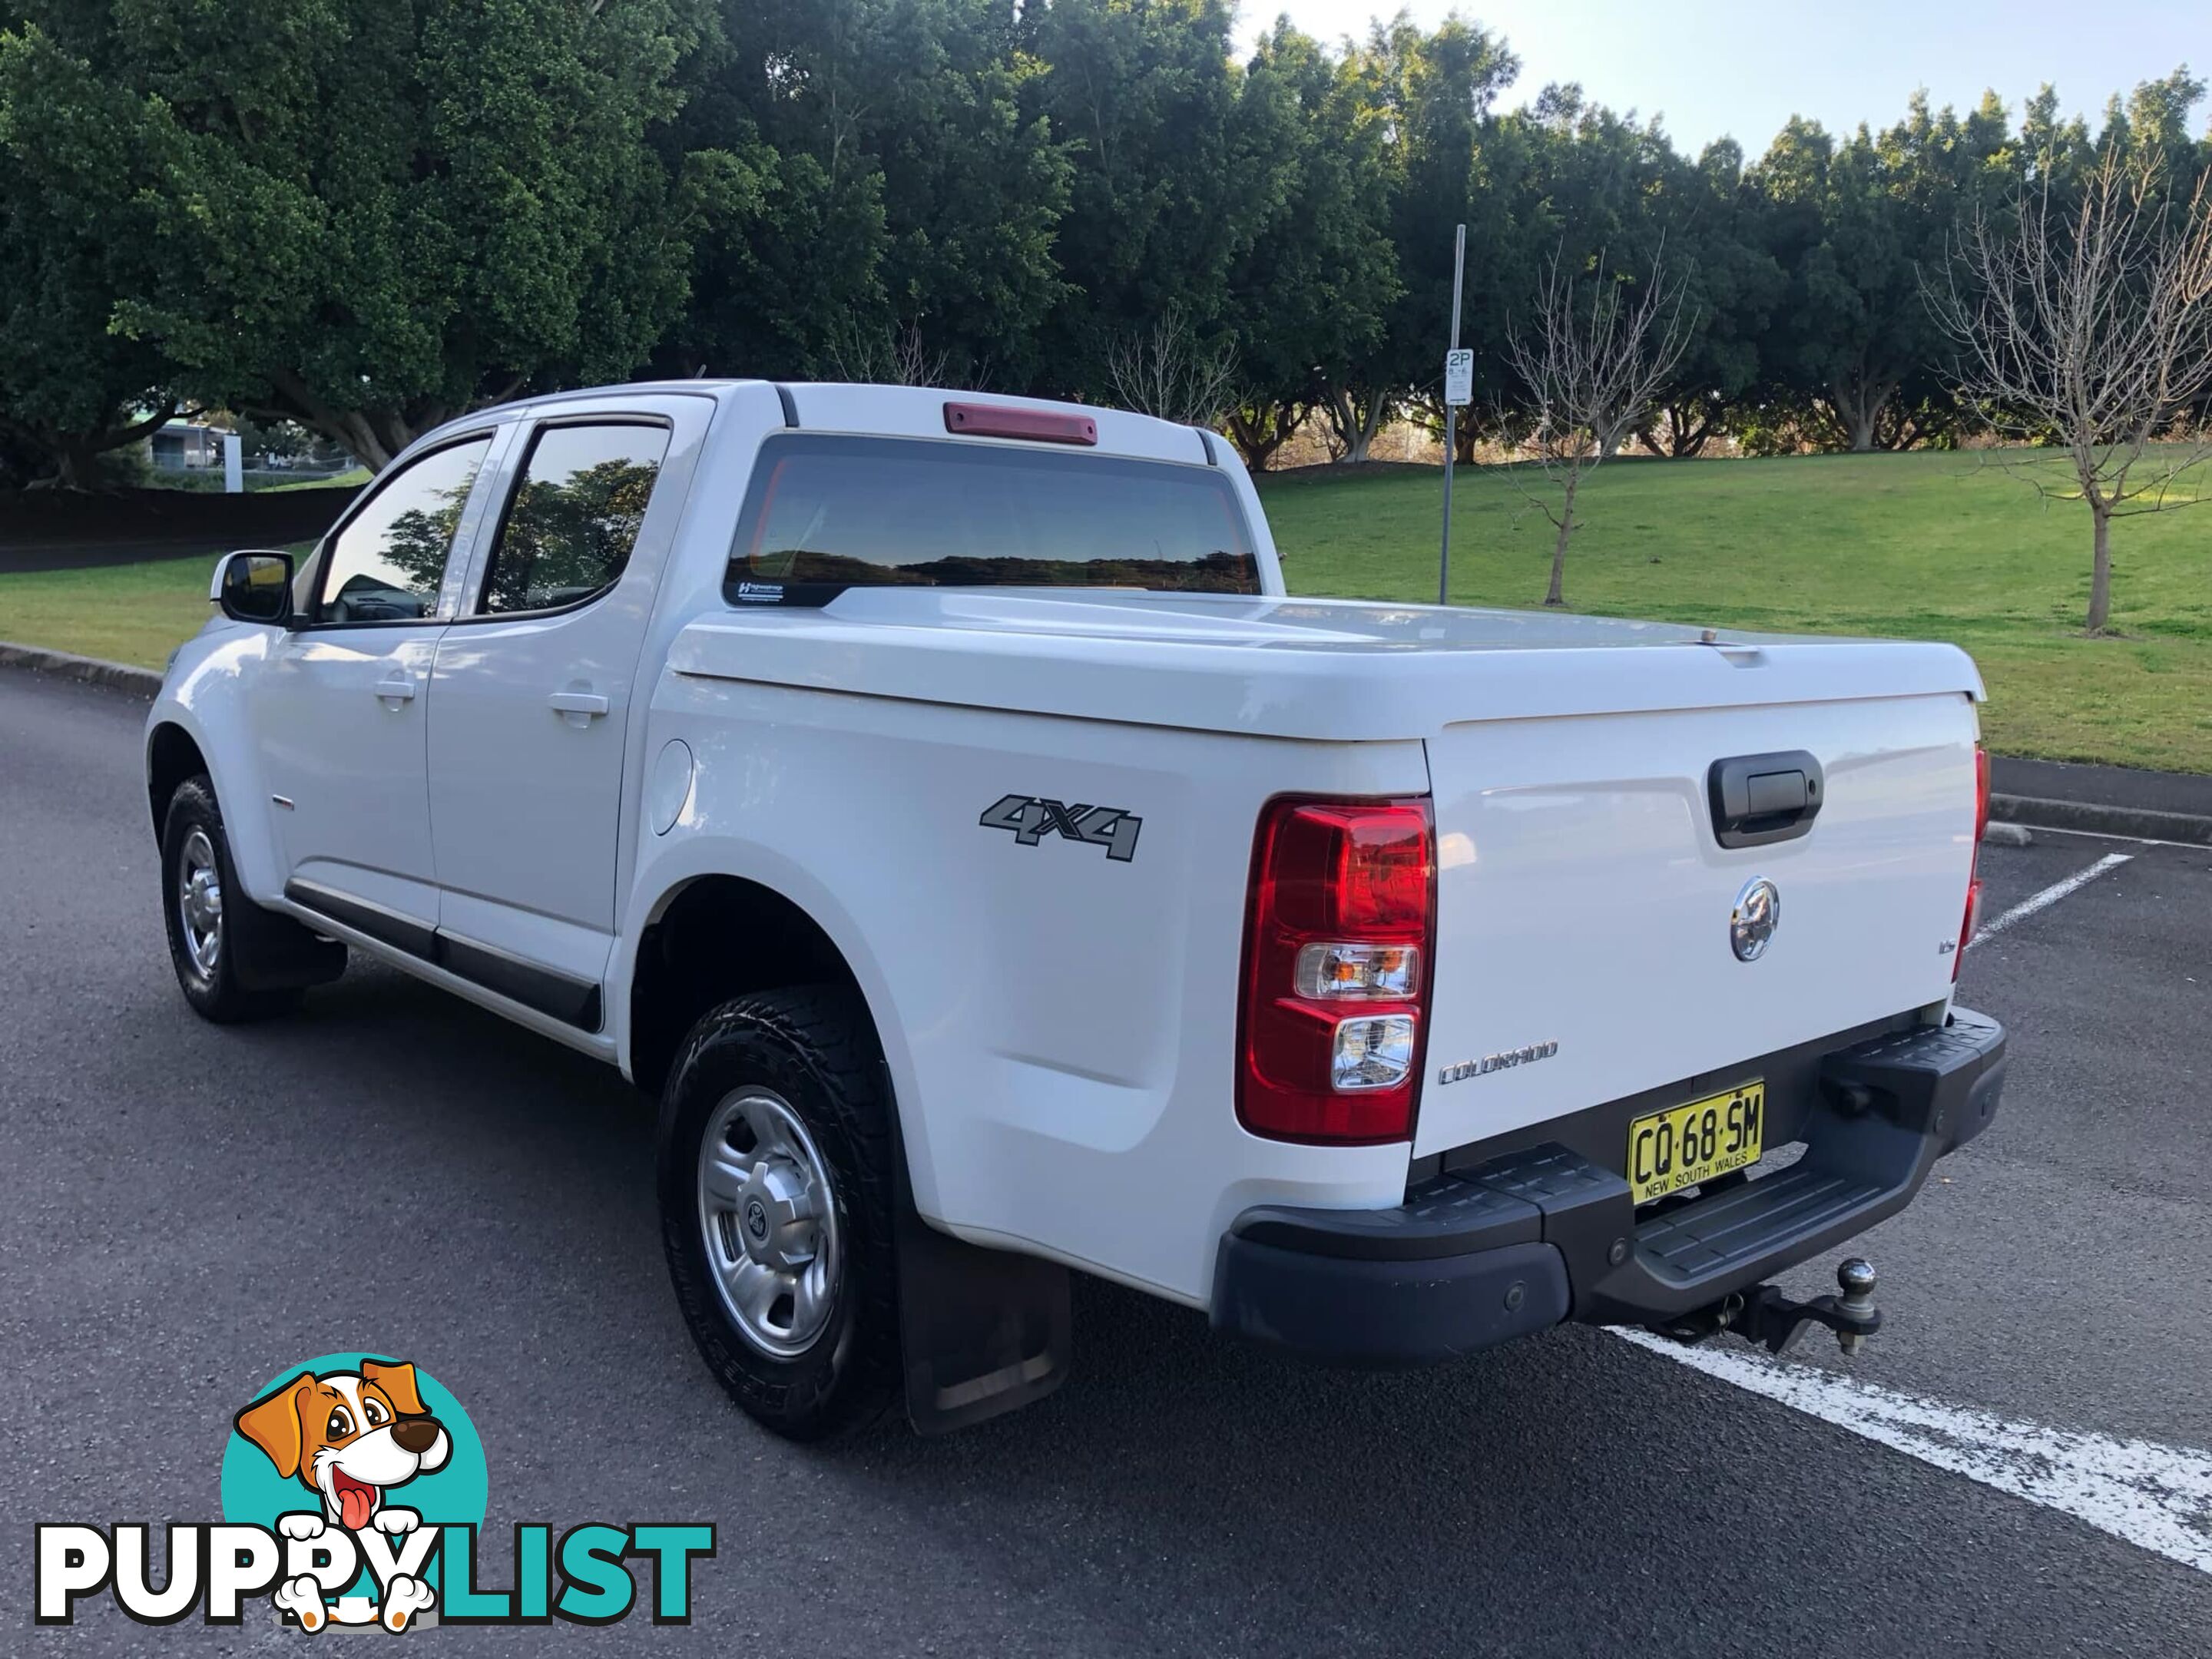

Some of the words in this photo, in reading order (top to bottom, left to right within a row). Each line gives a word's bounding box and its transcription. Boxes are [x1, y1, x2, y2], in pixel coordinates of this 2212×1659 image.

[1449, 353, 1470, 366] 2P
[1439, 1039, 1558, 1085] COLORADO
[1645, 1180, 1670, 1197] NEW
[1675, 1166, 1710, 1187] SOUTH
[1715, 1152, 1747, 1172] WALES
